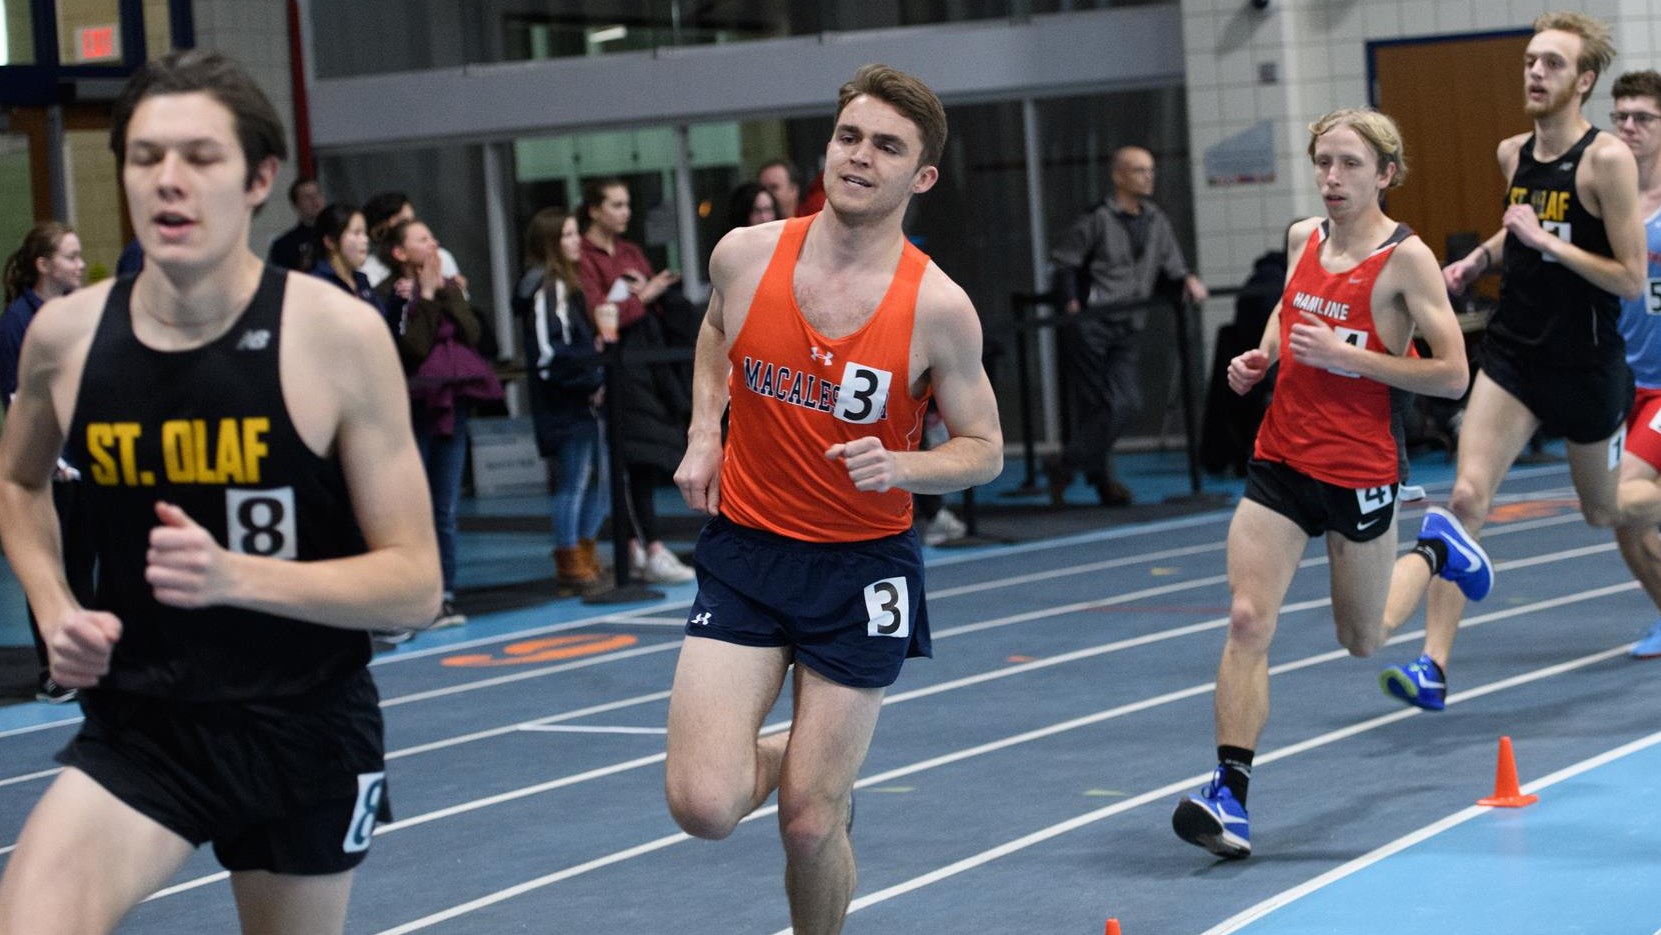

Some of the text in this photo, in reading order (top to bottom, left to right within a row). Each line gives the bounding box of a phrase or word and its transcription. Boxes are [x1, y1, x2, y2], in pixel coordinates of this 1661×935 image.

[1293, 291, 1349, 321] HAMLINE
[744, 356, 888, 419] MACALES
[843, 369, 878, 421] 3
[86, 417, 270, 486] ST. OLAF
[1365, 487, 1386, 505] 4
[236, 497, 284, 557] 8
[873, 582, 902, 635] 3
[353, 779, 382, 845] 8
